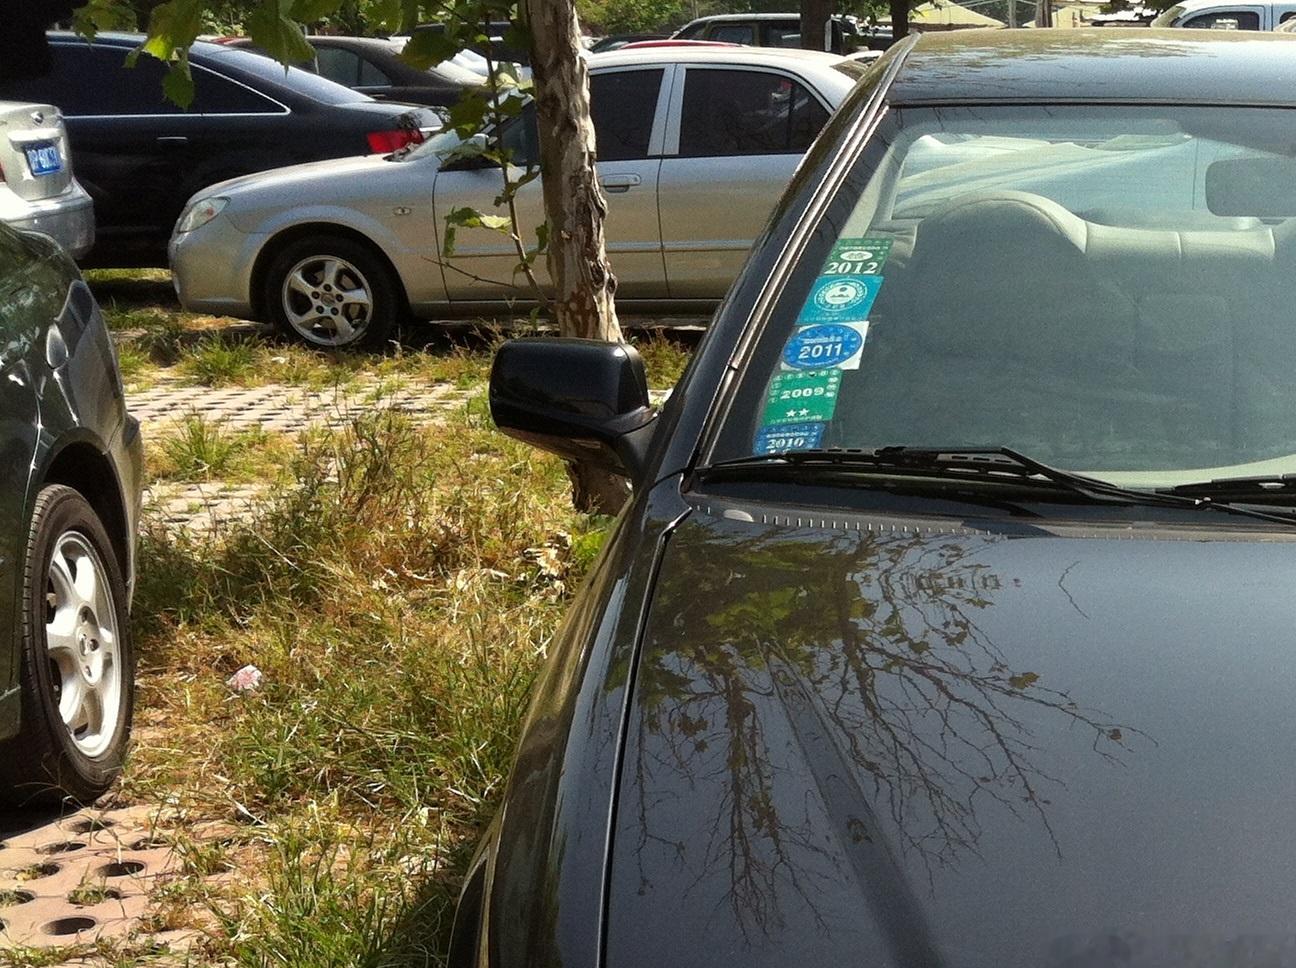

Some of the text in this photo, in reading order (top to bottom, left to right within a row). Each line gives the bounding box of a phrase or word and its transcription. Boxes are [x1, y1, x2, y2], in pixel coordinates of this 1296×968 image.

[824, 262, 878, 274] 2012
[799, 343, 842, 359] 2011
[780, 387, 824, 400] 2009
[766, 437, 804, 449] 2010
